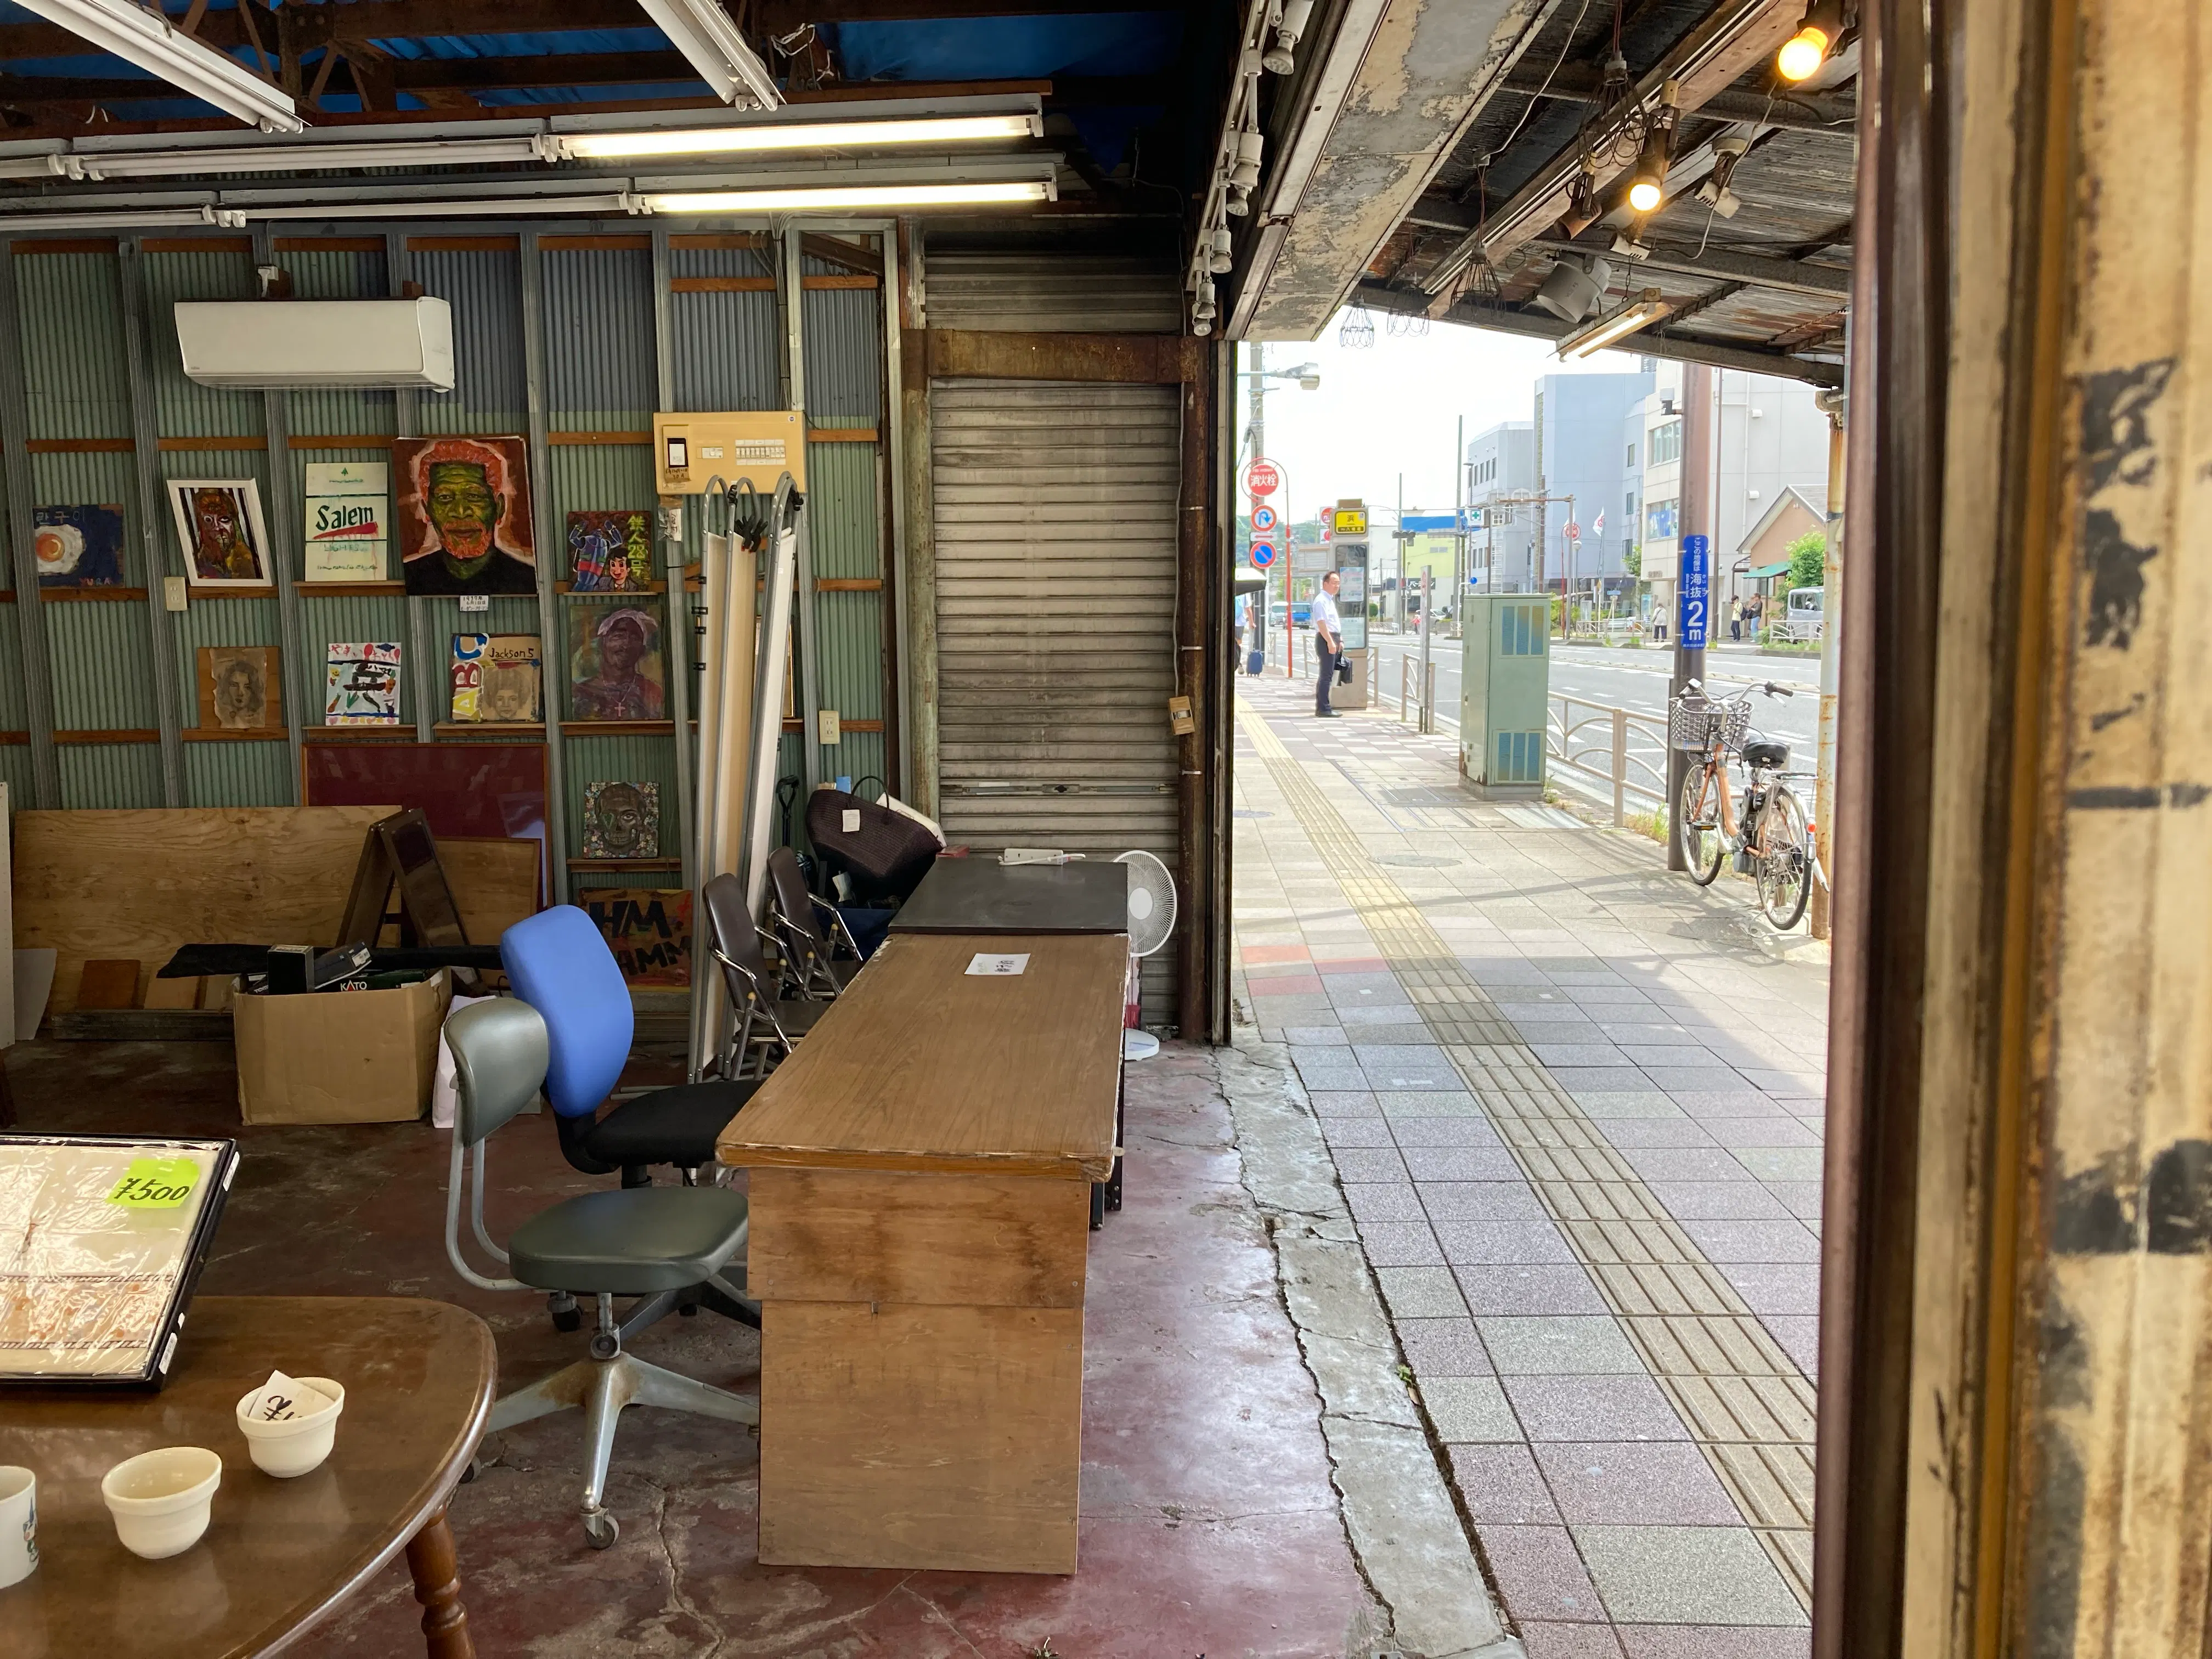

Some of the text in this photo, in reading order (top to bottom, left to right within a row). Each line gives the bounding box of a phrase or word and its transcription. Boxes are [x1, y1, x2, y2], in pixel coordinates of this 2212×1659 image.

[1250, 474, 1277, 487] 消火栓
[315, 505, 373, 531] Salem
[489, 648, 534, 658] Jackson 5
[340, 980, 367, 991] KATO
[114, 1178, 190, 1200] ¥500
